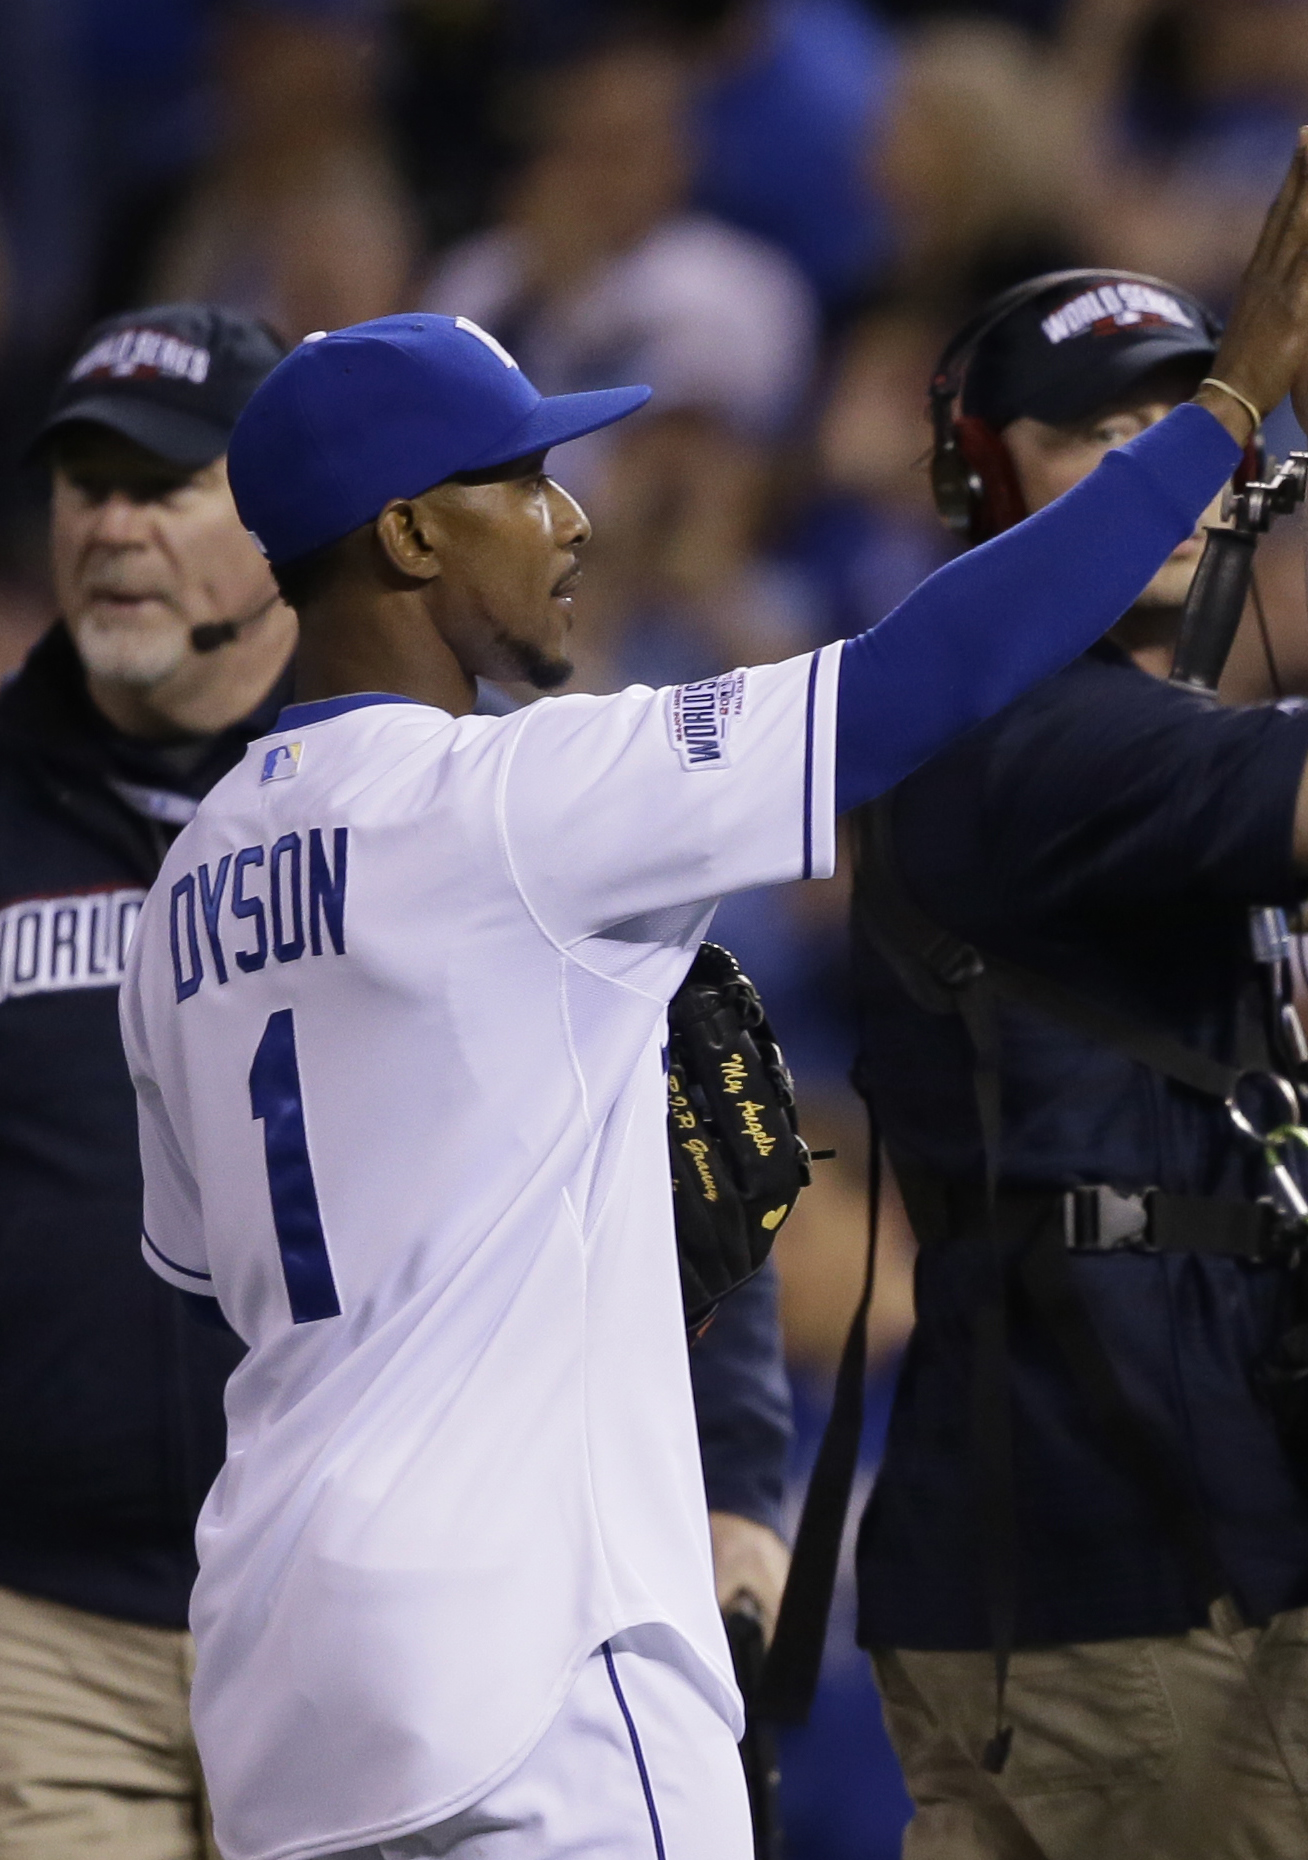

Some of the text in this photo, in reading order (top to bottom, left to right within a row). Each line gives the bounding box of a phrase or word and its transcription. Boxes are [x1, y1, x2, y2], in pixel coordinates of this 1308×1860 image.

[682, 693, 721, 764] WORLD
[0, 900, 142, 984] ORLD
[170, 827, 348, 1005] DYSON
[720, 1053, 777, 1157] My Angels
[249, 1008, 342, 1325] 1
[682, 1138, 719, 1202] Granny
